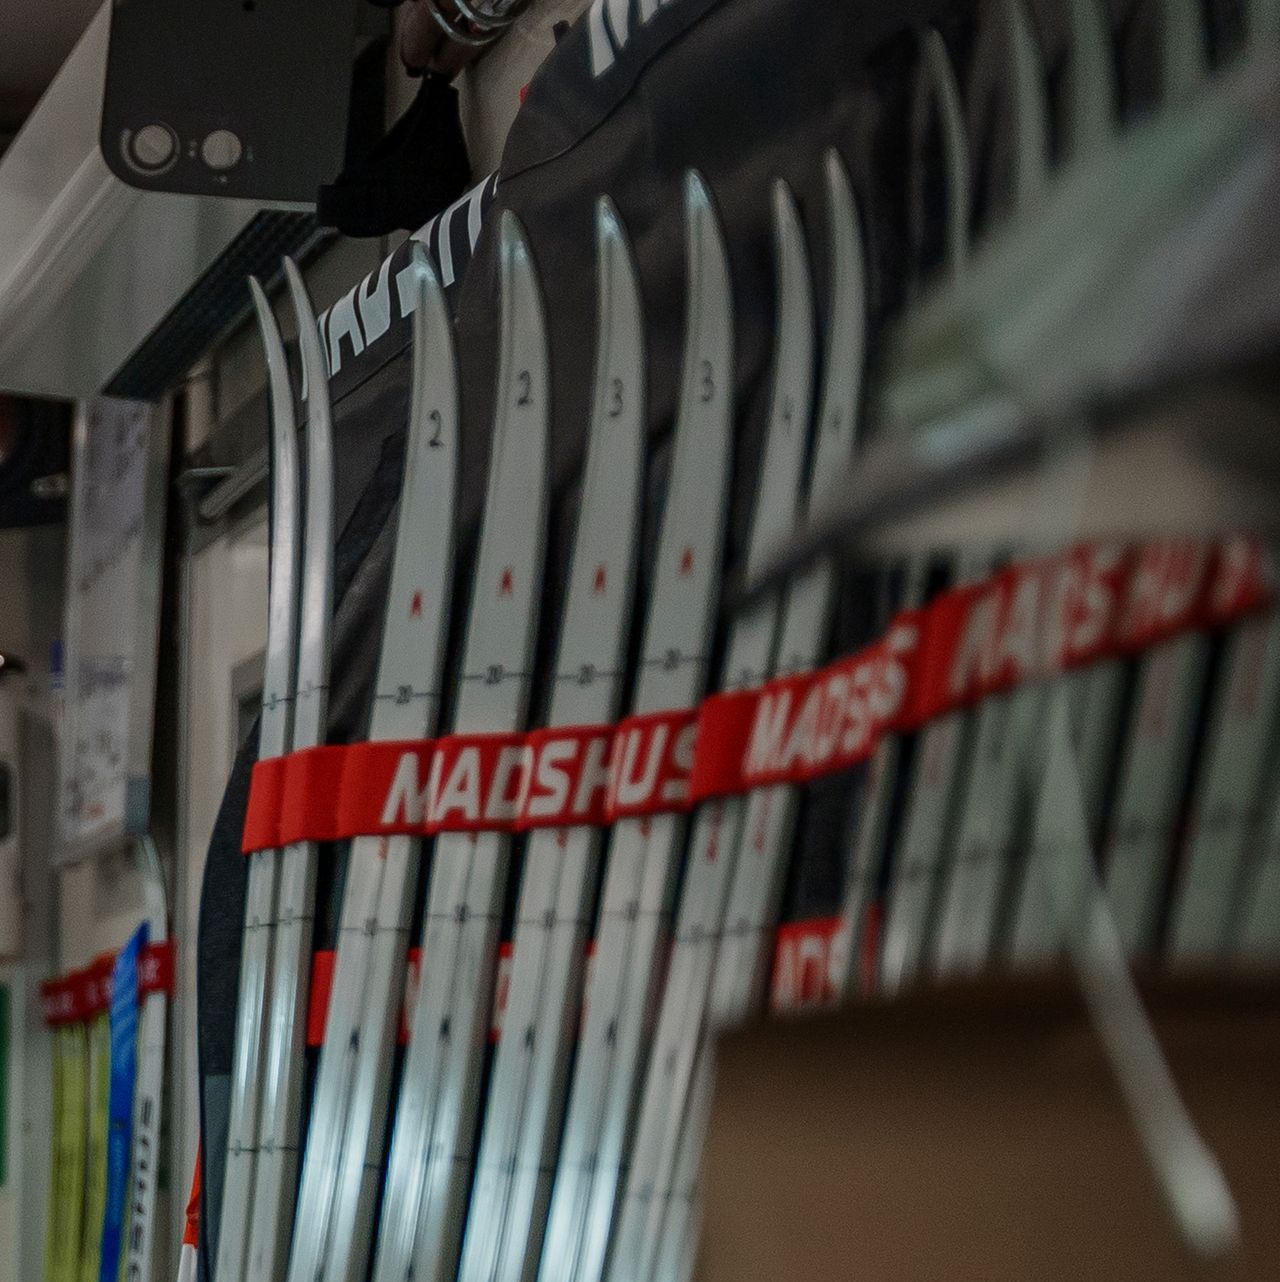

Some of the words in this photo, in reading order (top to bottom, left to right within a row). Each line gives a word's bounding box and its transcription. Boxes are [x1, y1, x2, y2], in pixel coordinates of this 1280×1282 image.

[517, 369, 532, 407] 2
[609, 377, 624, 418] 3
[429, 408, 443, 448] 2
